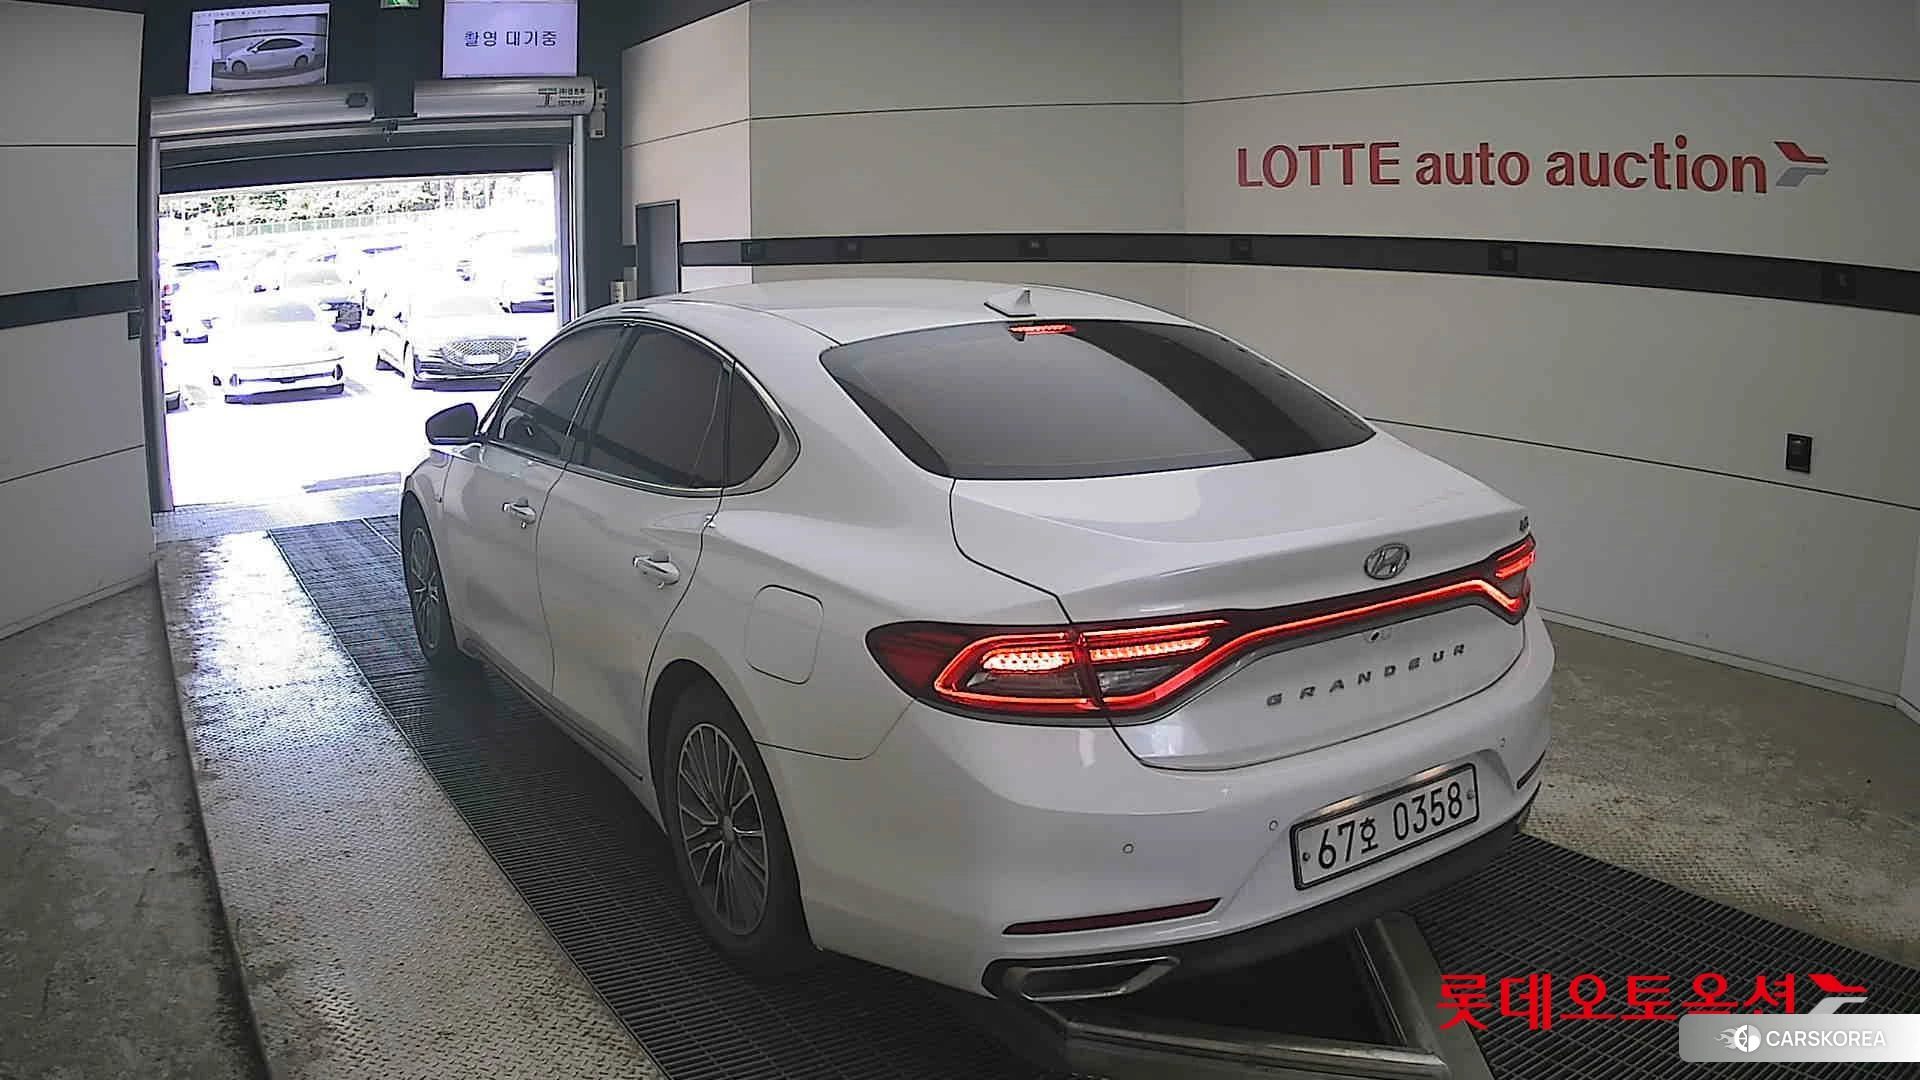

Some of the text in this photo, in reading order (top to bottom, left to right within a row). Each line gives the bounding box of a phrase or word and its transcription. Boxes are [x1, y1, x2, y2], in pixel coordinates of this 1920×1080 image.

[505, 31, 557, 47] 대기중
[1237, 135, 1767, 193] LOTTE auto auction
[1266, 644, 1465, 707] GRANDEUR
[1318, 782, 1463, 869] 67호 0358
